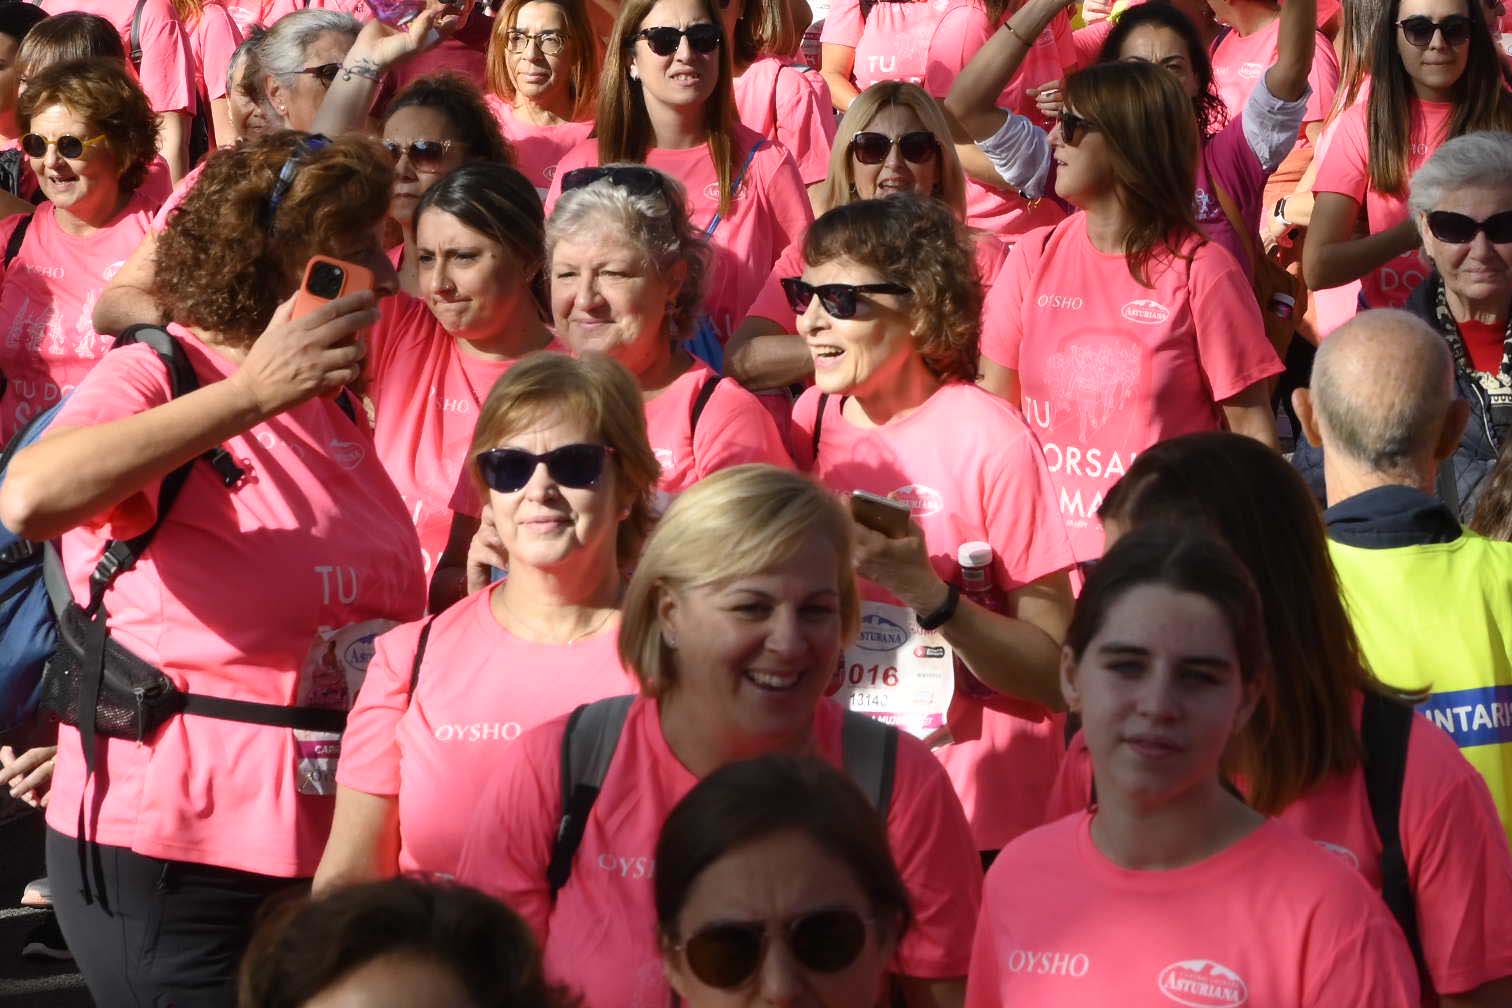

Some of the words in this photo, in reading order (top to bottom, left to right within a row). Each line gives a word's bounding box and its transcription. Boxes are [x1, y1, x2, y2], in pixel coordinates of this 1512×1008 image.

[867, 55, 896, 73] TU
[26, 263, 65, 280] YSHO
[1047, 443, 1140, 479] ORSA
[1059, 487, 1104, 519] MA
[313, 564, 357, 605] TU
[842, 663, 899, 687] 016
[434, 721, 522, 743] OYSHO
[597, 852, 655, 880] OYS
[1007, 948, 1091, 978] OYSHO
[1162, 969, 1241, 1004] ASTURIANA
